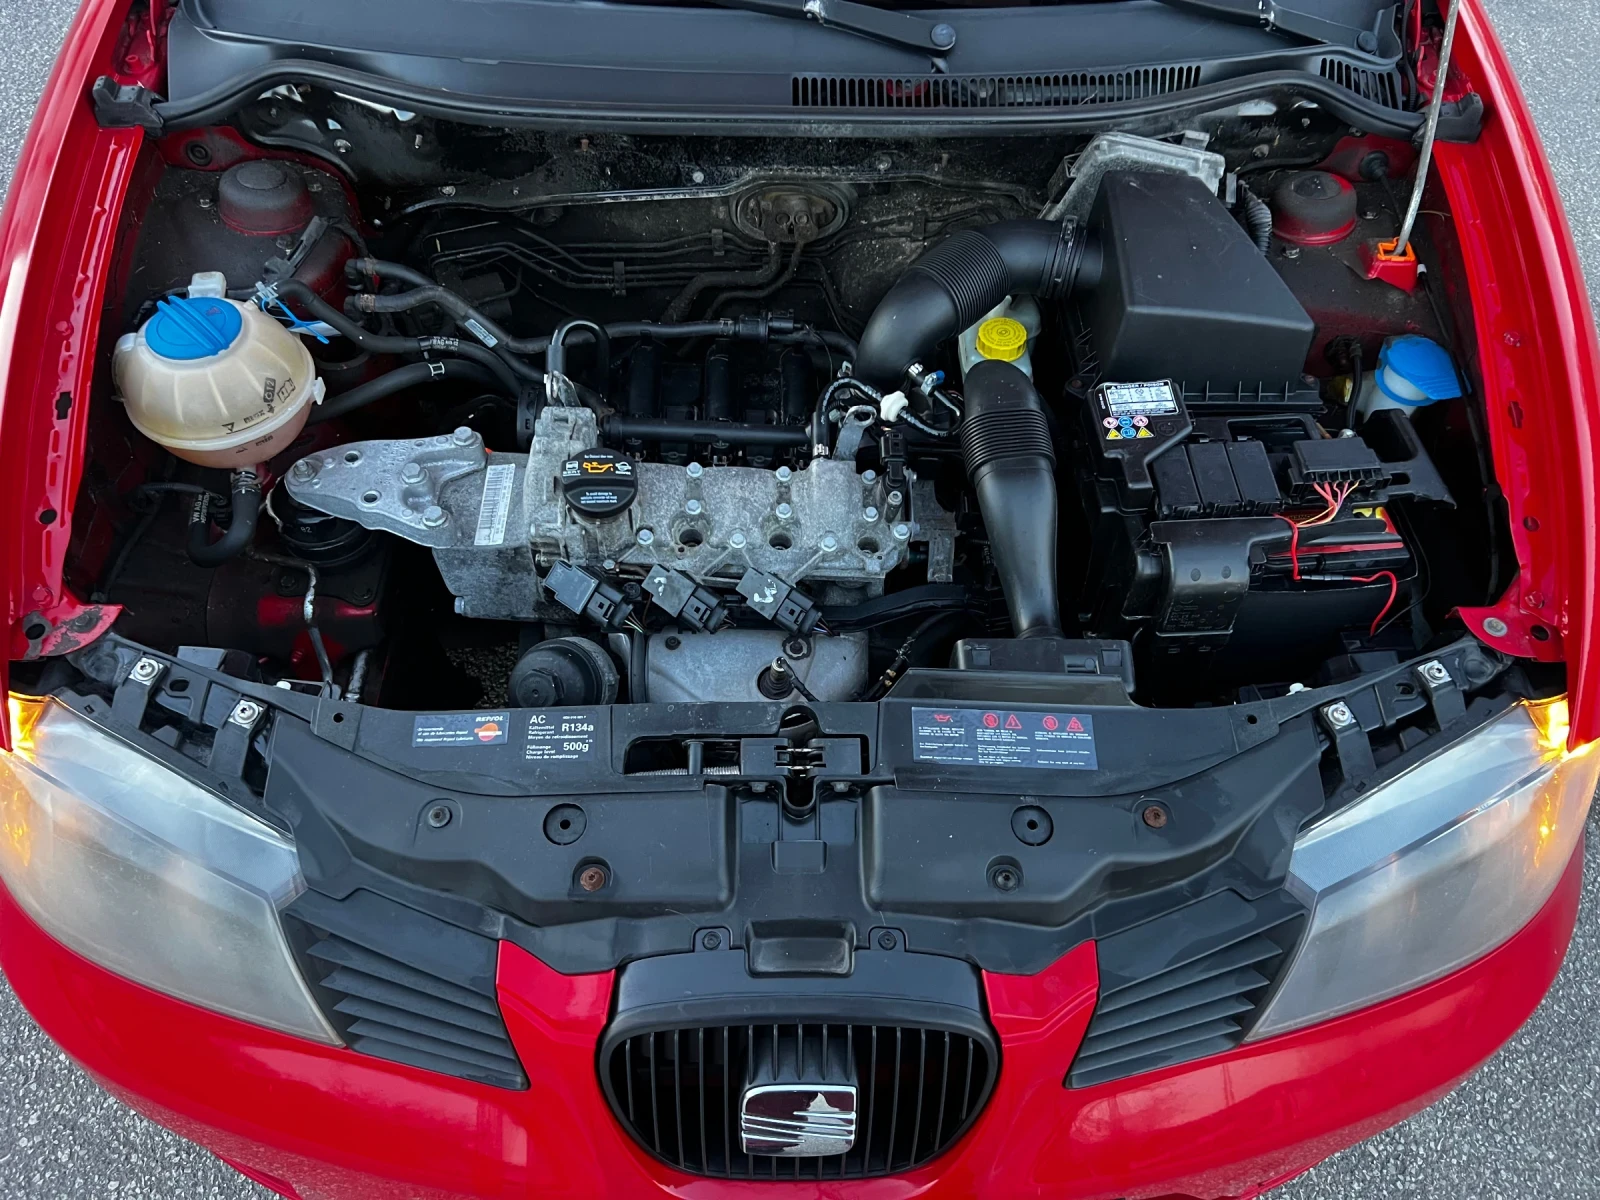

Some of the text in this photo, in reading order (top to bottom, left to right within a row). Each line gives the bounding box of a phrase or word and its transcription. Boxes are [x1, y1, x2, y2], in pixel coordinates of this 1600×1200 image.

[529, 714, 546, 724] AC
[561, 723, 594, 732] R134a
[563, 742, 589, 752] 500g
